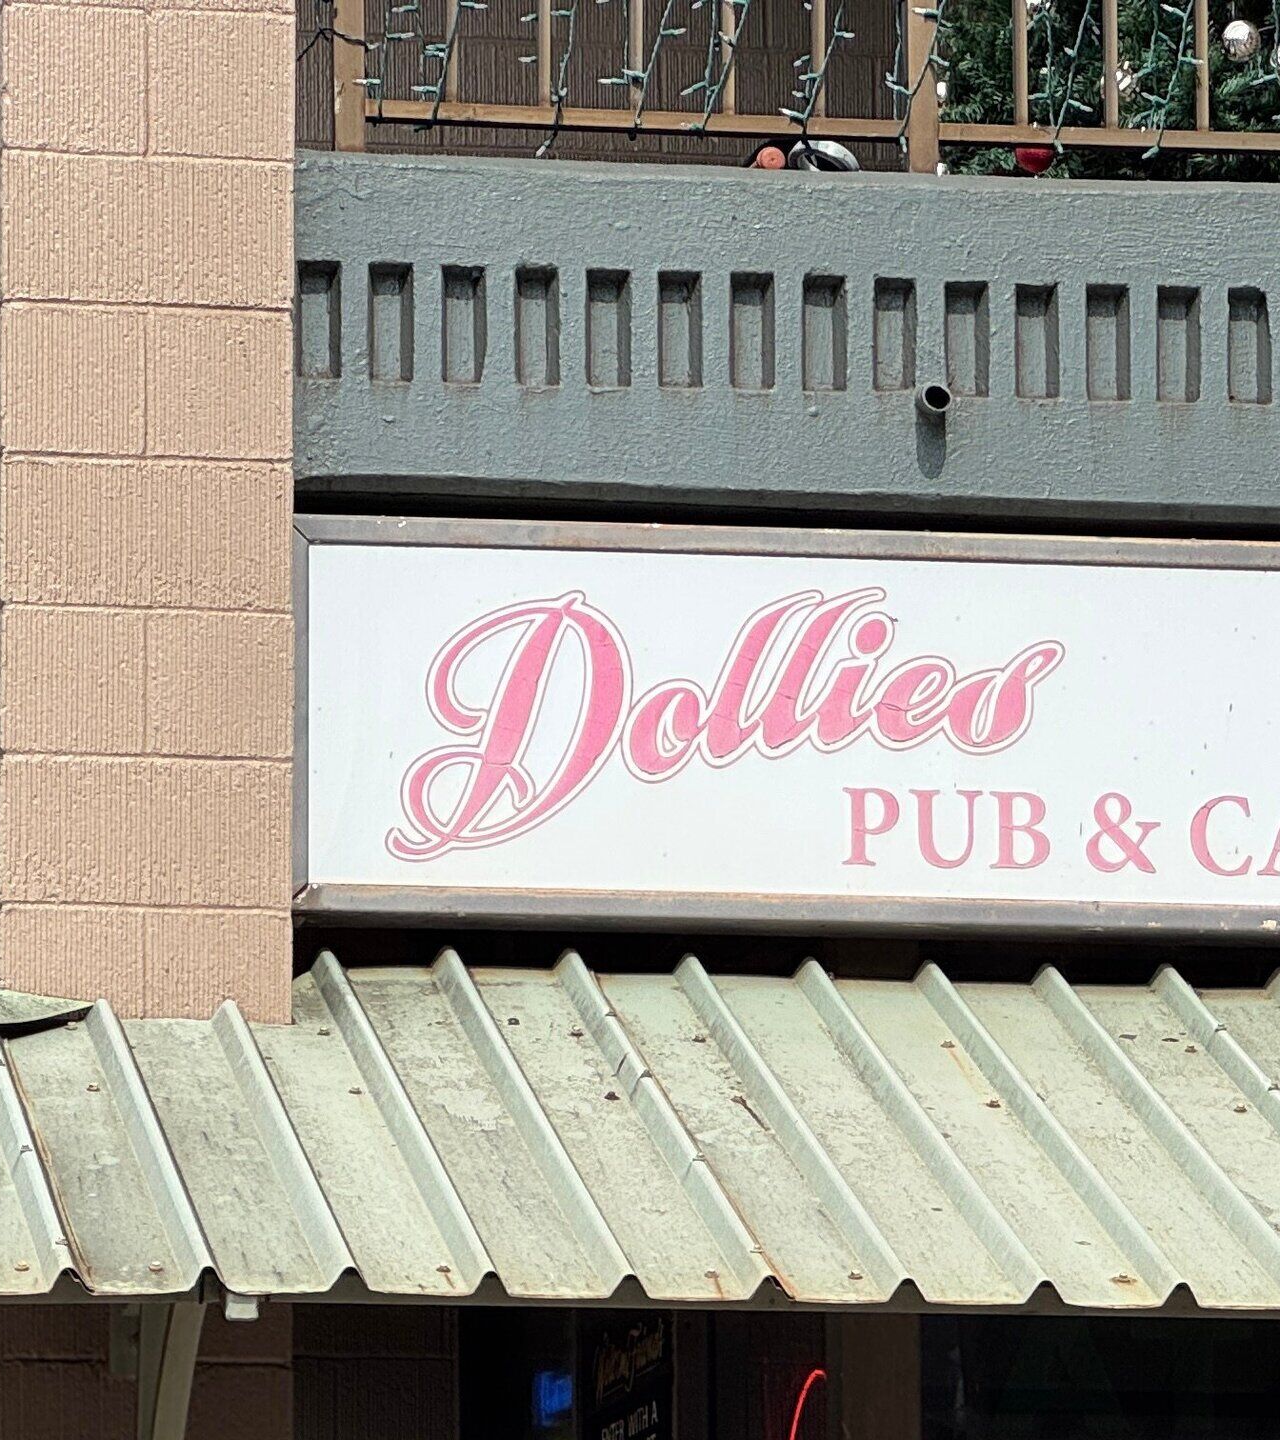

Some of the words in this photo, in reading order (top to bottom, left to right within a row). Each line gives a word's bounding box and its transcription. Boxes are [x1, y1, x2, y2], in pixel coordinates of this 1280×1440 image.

[387, 585, 1065, 862] Dollies
[842, 787, 1052, 870] PUB
[1085, 791, 1161, 876] &
[650, 1399, 659, 1427] A
